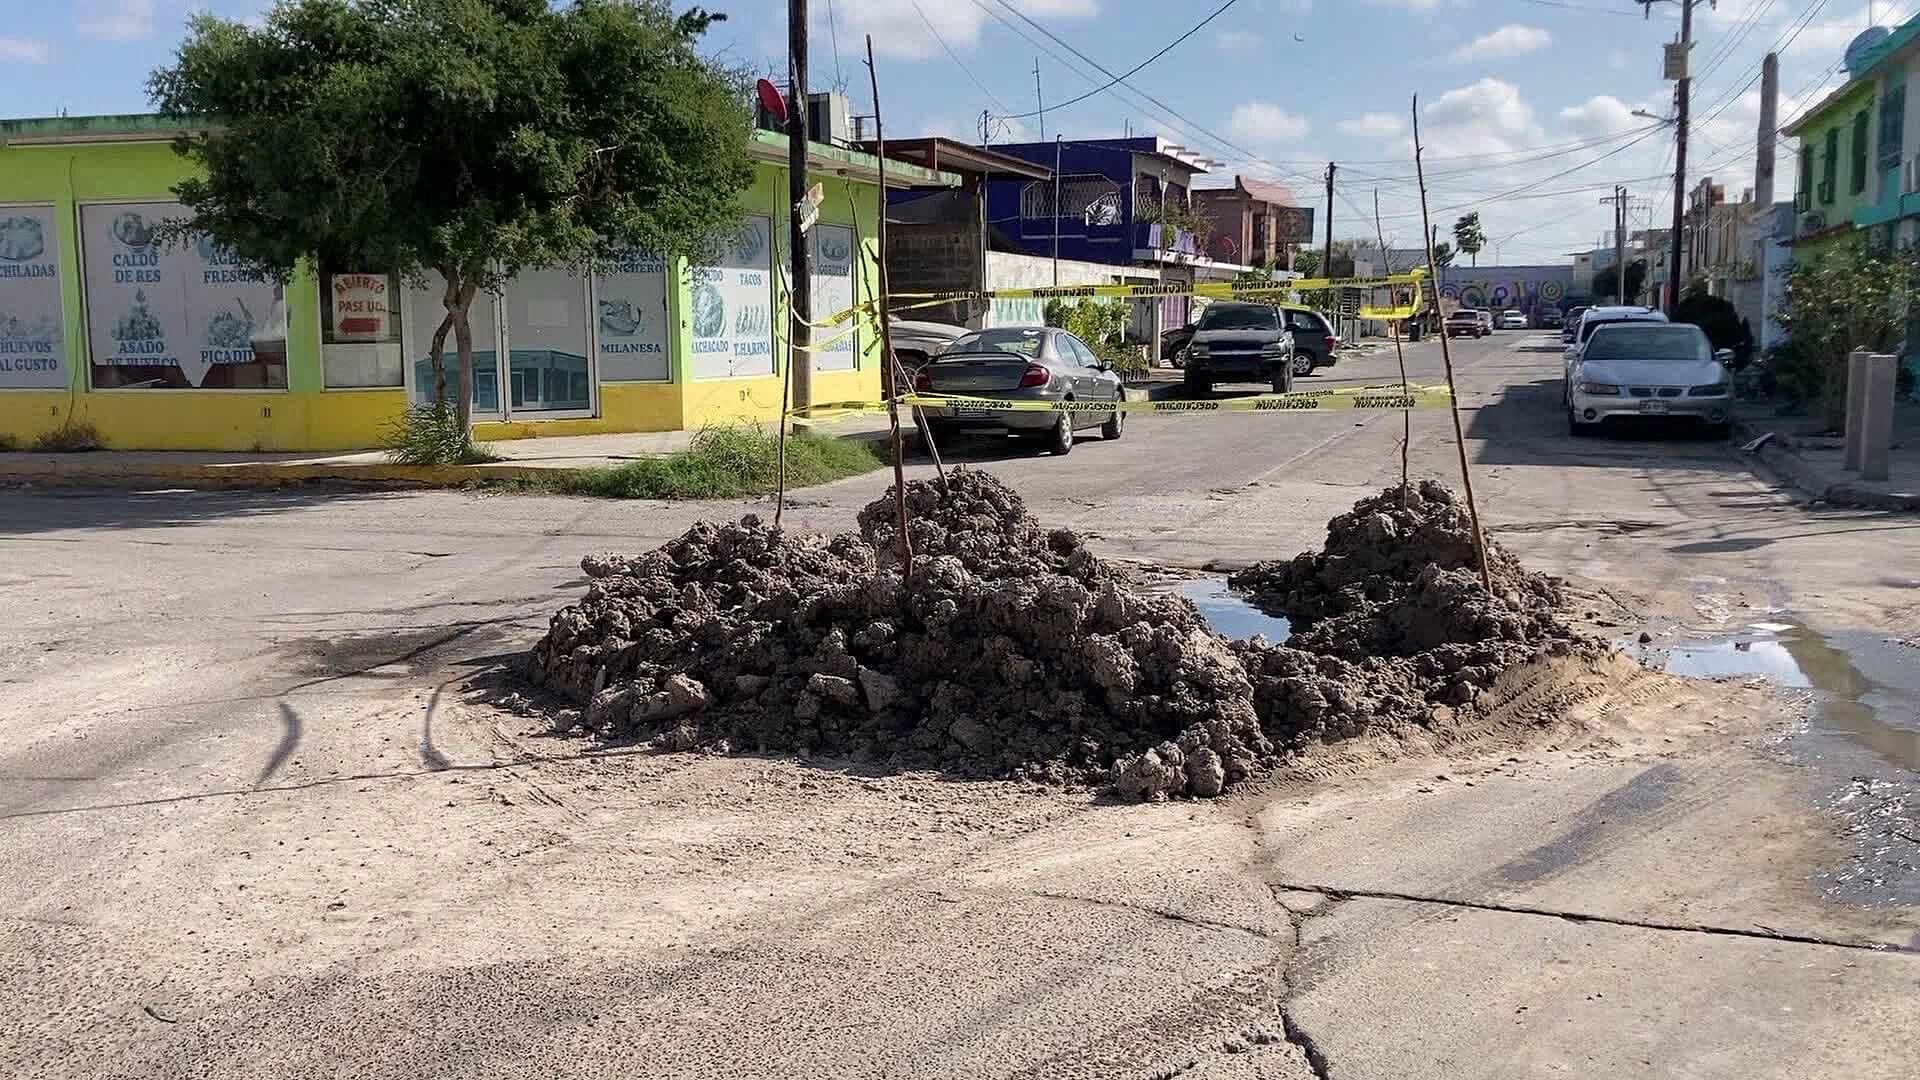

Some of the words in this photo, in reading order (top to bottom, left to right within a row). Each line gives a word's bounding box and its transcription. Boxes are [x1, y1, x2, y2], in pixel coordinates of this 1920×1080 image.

[113, 254, 158, 266] CALDO
[115, 270, 134, 282] DE
[136, 270, 161, 282] RES
[739, 273, 761, 286] TACOS
[335, 275, 385, 295] ABIERTO
[338, 301, 363, 313] PASE
[1, 341, 51, 353] HUEVOS
[119, 341, 164, 353] ASADO
[600, 343, 661, 353] MILANESA
[15, 358, 57, 371] GUSTO
